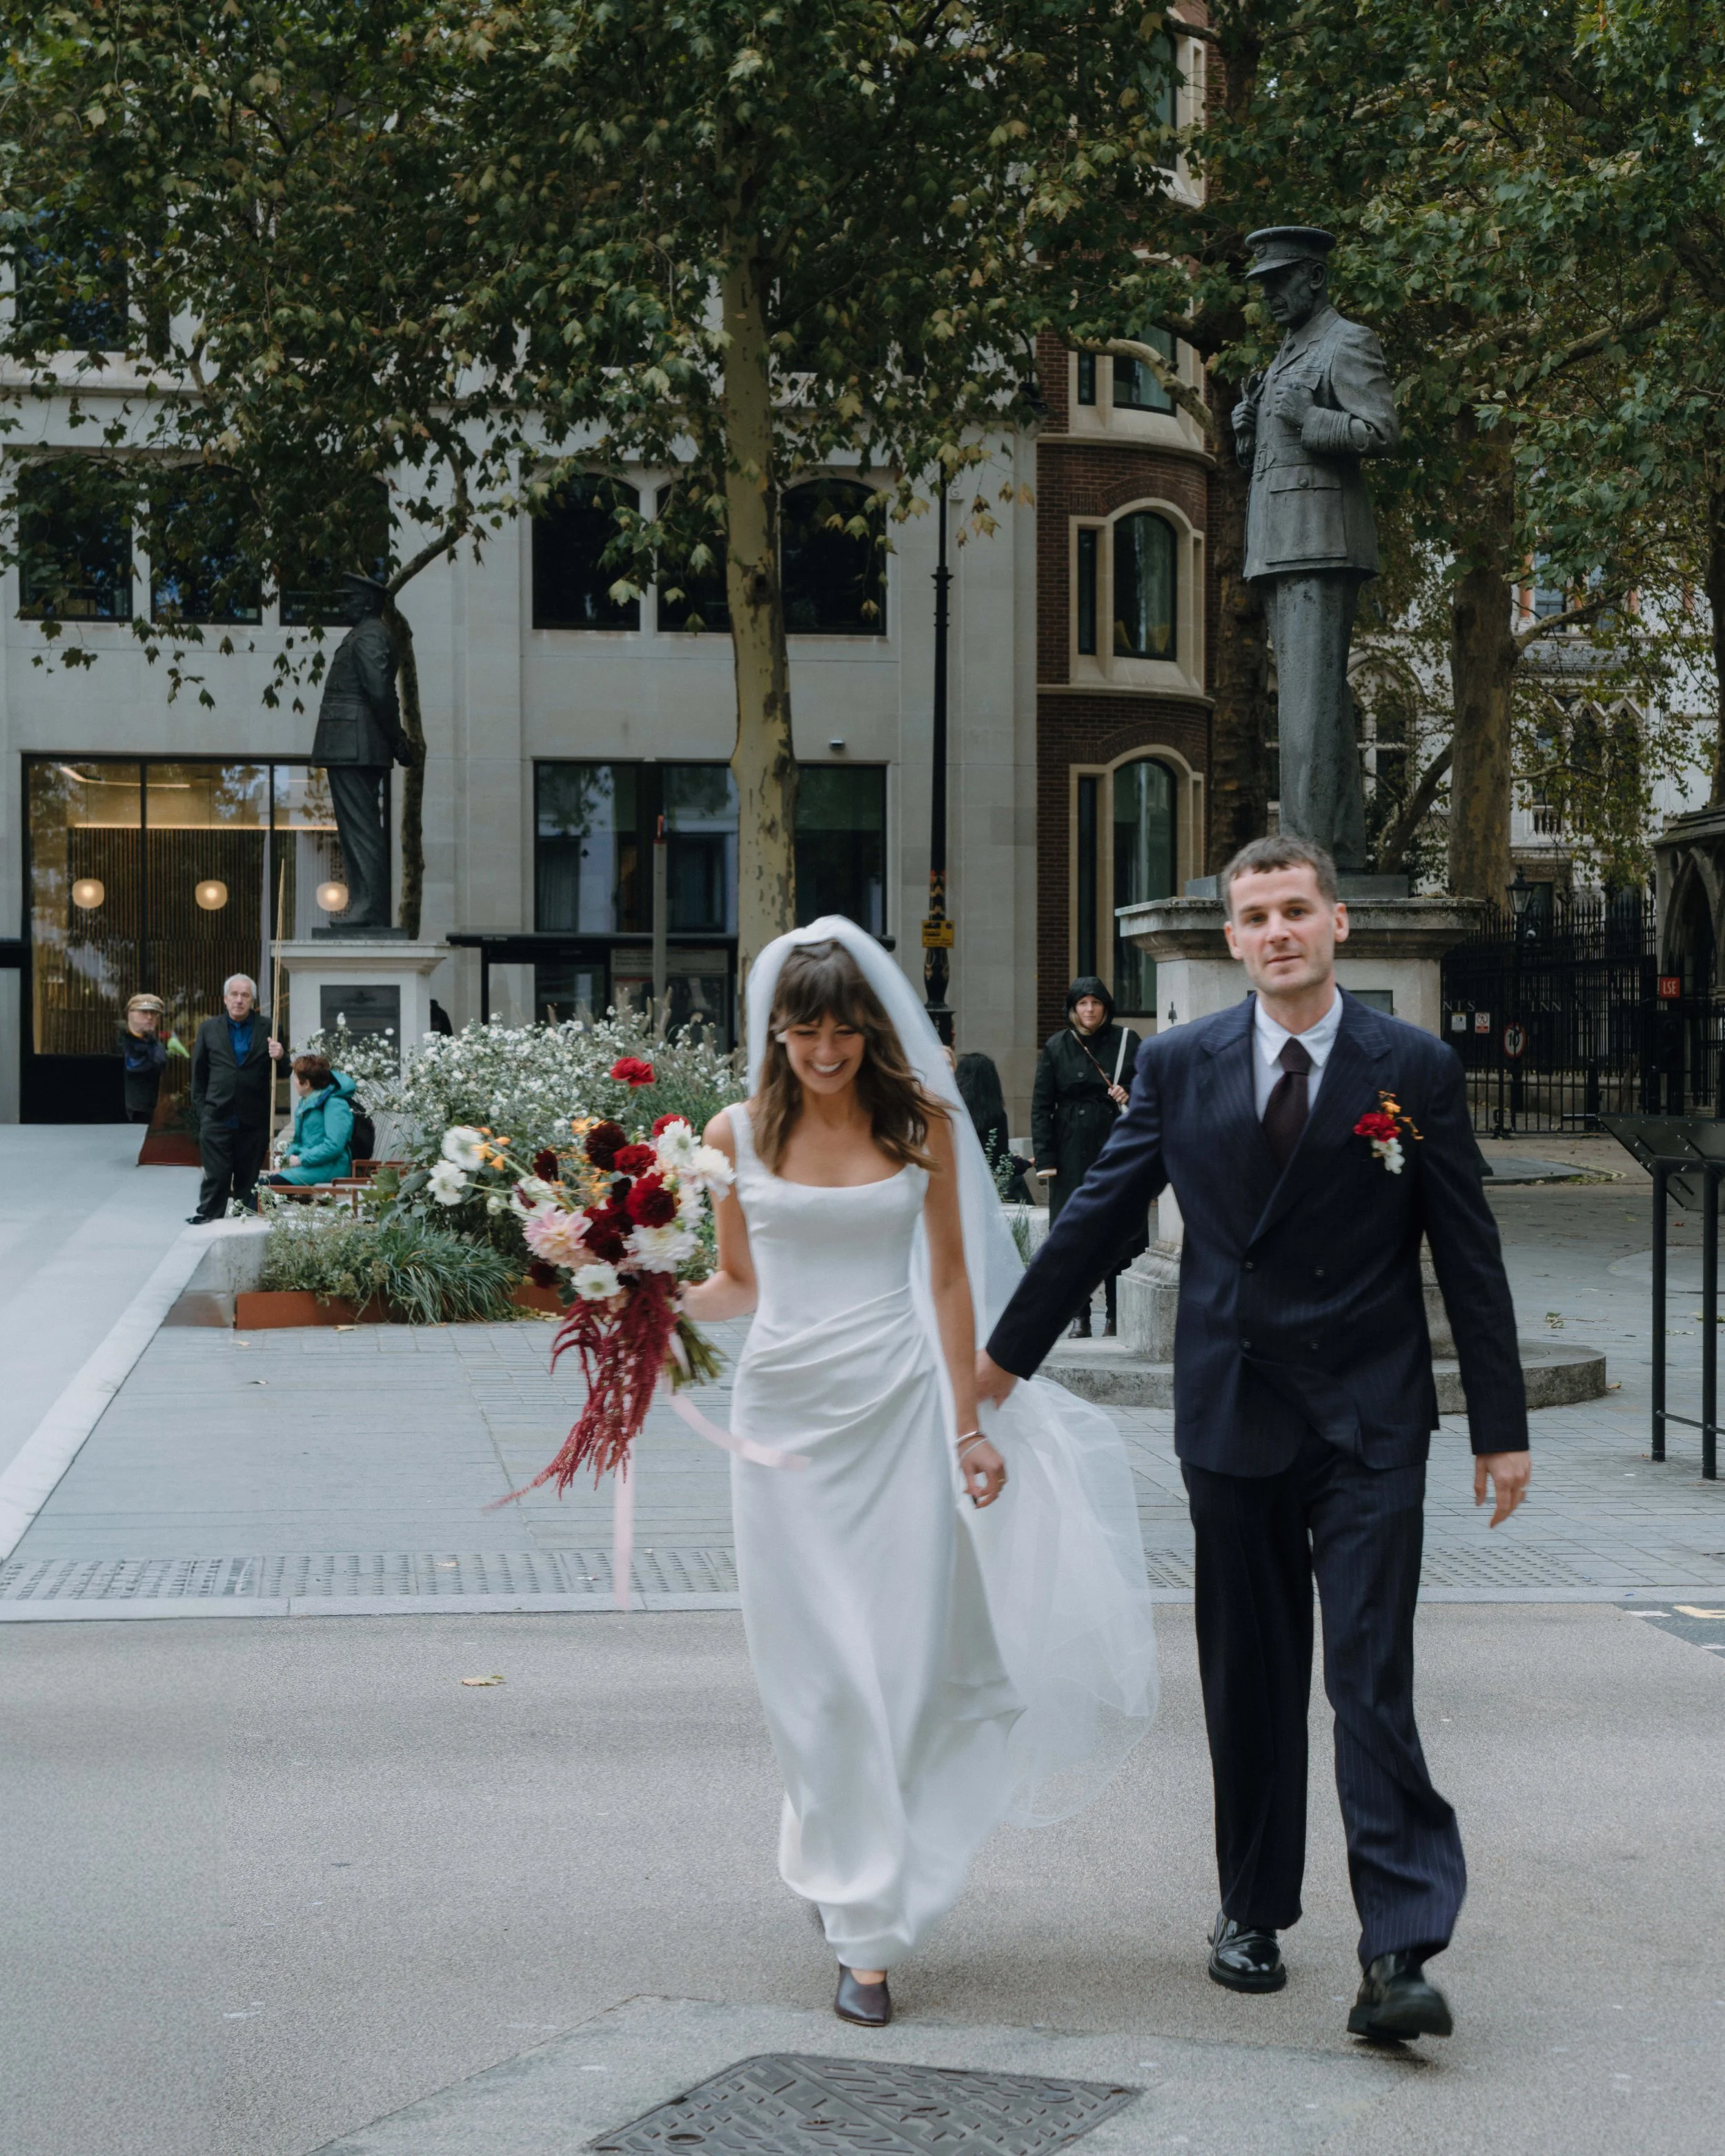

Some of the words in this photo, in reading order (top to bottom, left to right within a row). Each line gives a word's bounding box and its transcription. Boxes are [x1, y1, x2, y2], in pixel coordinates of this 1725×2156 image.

[1663, 980, 1677, 994] LSE
[1531, 1000, 1562, 1012] INN
[1508, 1033, 1520, 1047] 10
